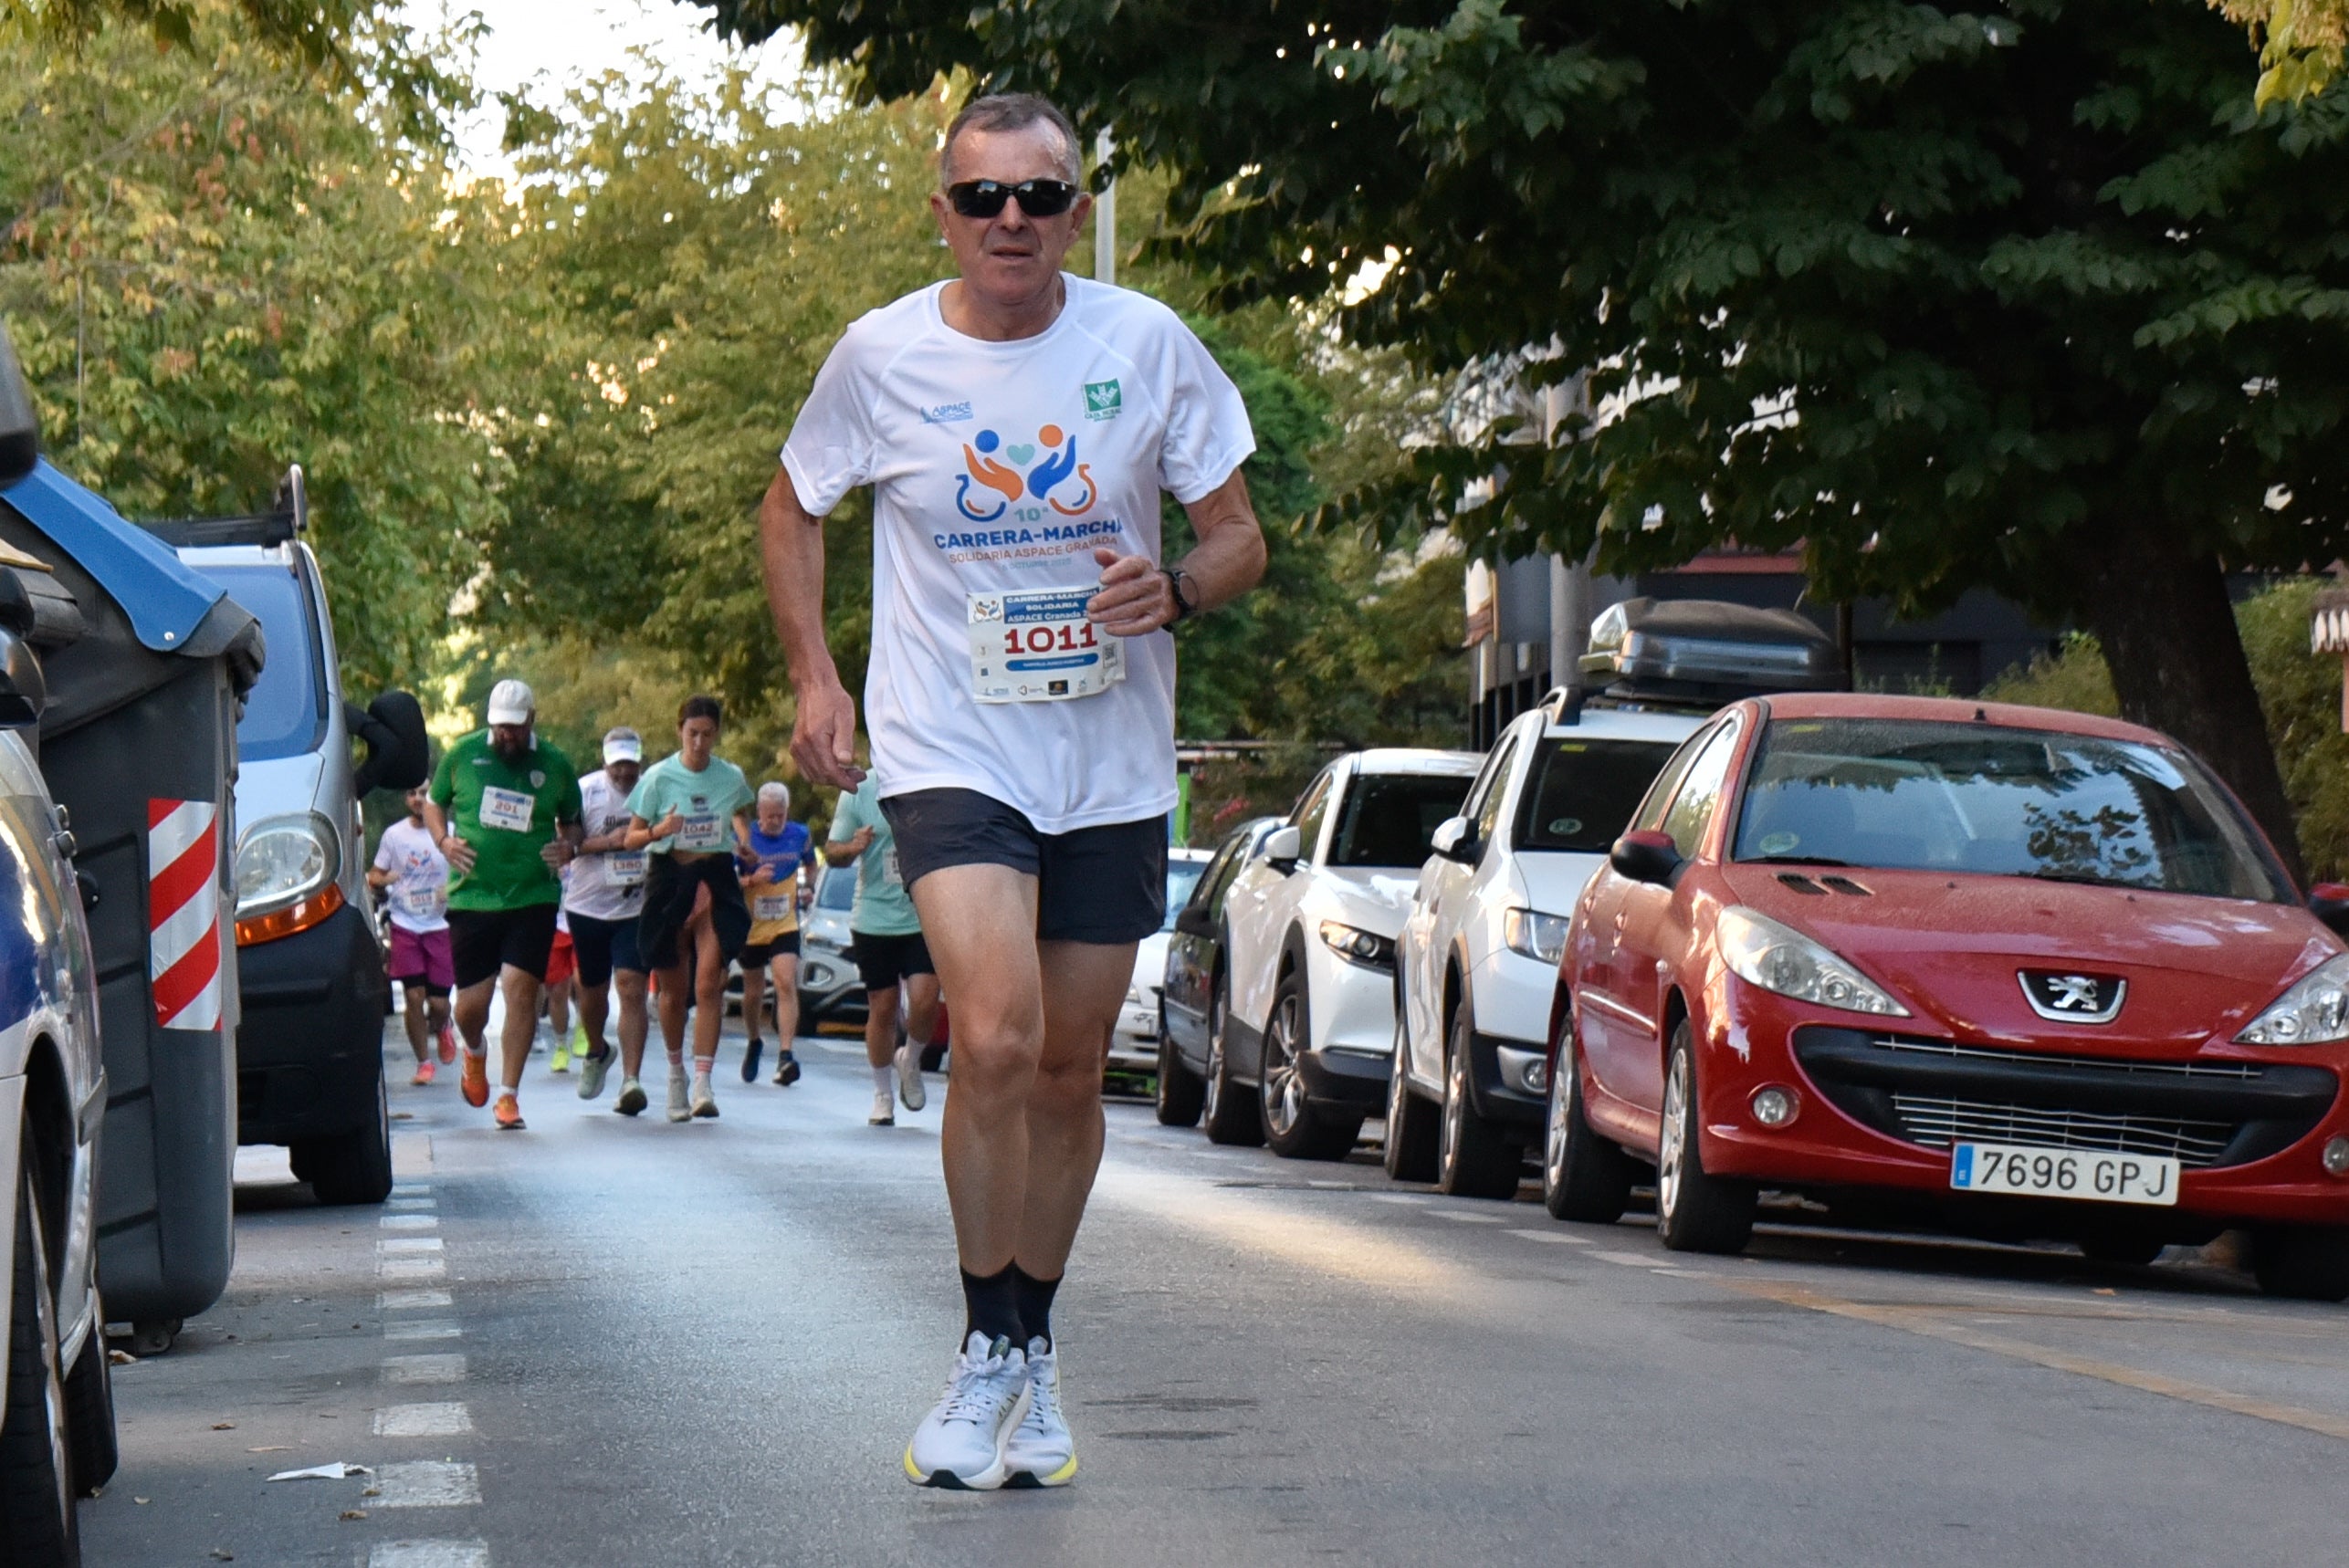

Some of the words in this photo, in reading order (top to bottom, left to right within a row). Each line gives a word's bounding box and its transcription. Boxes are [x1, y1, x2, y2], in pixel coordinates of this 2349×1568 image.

[949, 549, 1012, 564] SOLIDARIA
[1014, 545, 1063, 559] ASPACE
[1065, 536, 1118, 553] GRANADA
[1007, 613, 1043, 622] ASPACE
[1044, 612, 1081, 621] Granada
[1025, 601, 1079, 612] SOLIDARIA
[1004, 622, 1098, 653] 1011
[1981, 1151, 2078, 1190] 7696
[2094, 1160, 2167, 1197] GPJ
